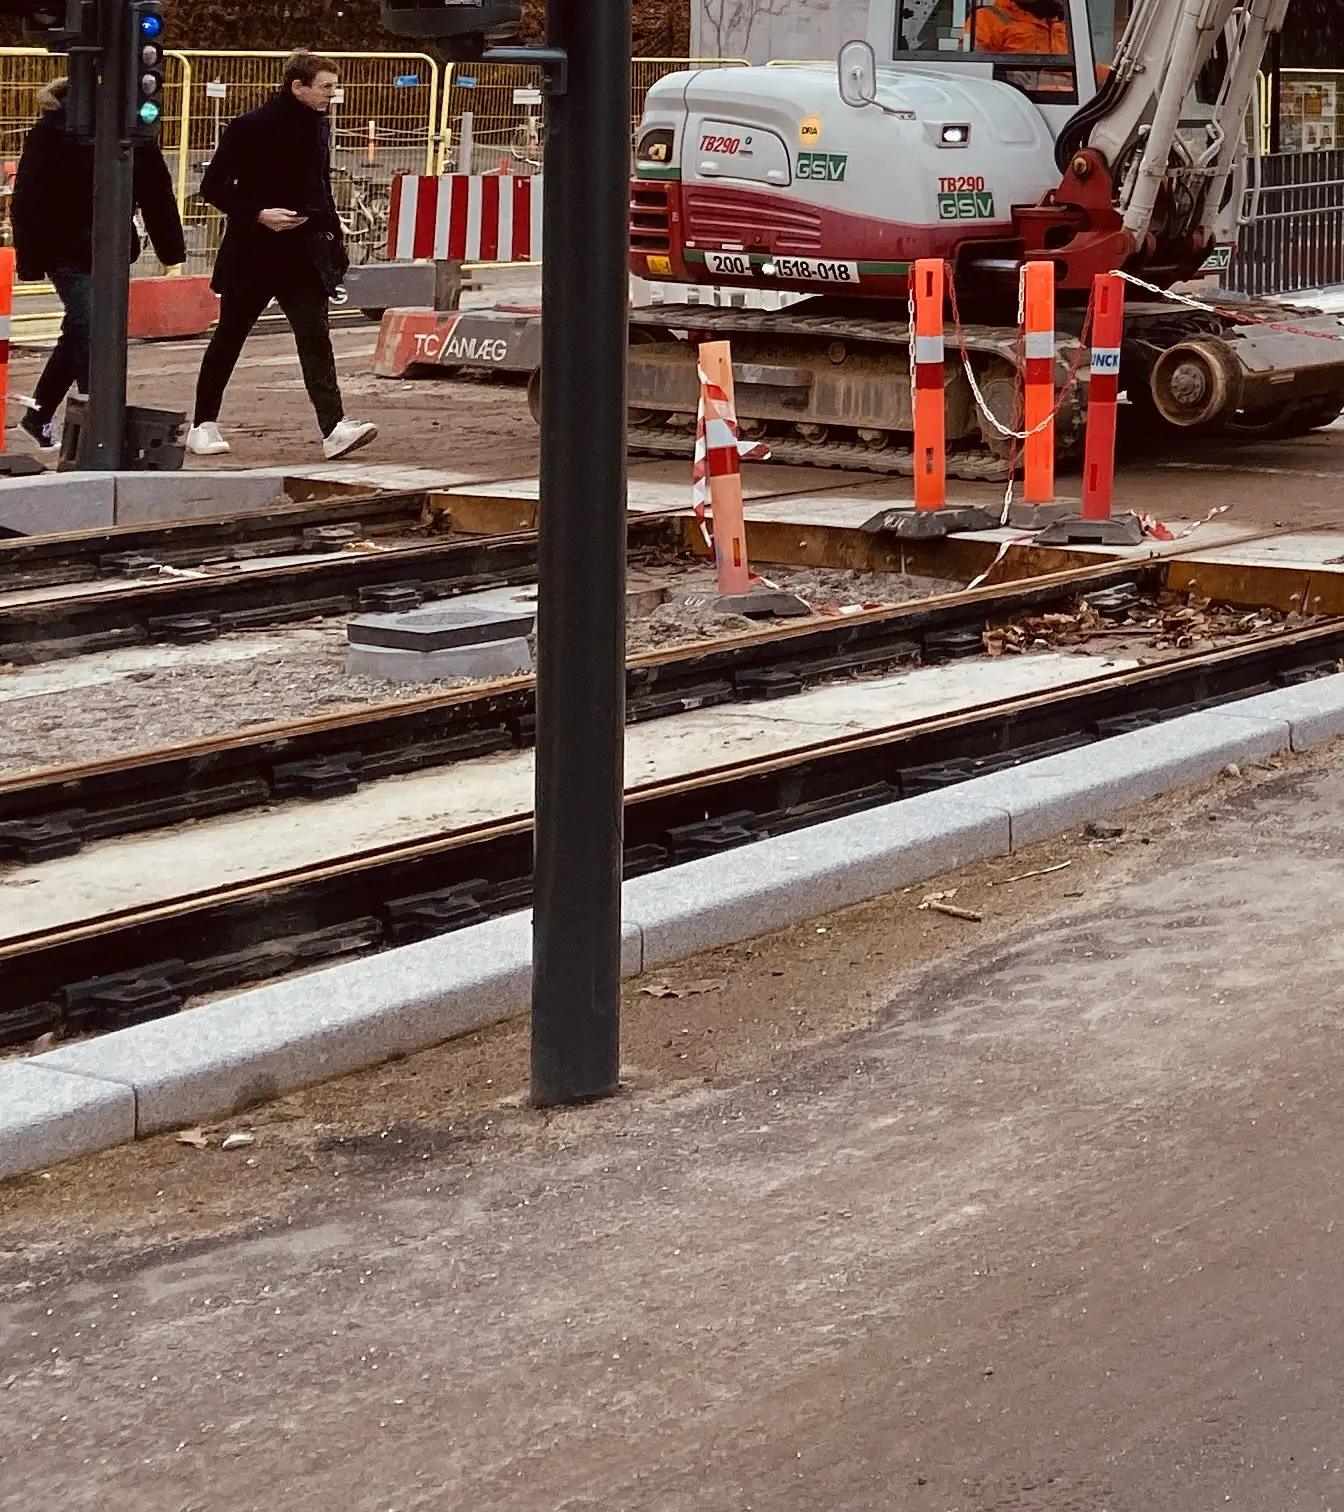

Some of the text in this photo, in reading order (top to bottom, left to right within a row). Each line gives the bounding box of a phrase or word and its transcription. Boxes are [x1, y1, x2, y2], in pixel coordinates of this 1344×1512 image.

[700, 135, 740, 155] TB290
[796, 159, 846, 180] GSV
[938, 176, 985, 193] TB290
[940, 198, 993, 218] GSV
[1202, 254, 1229, 268] SV
